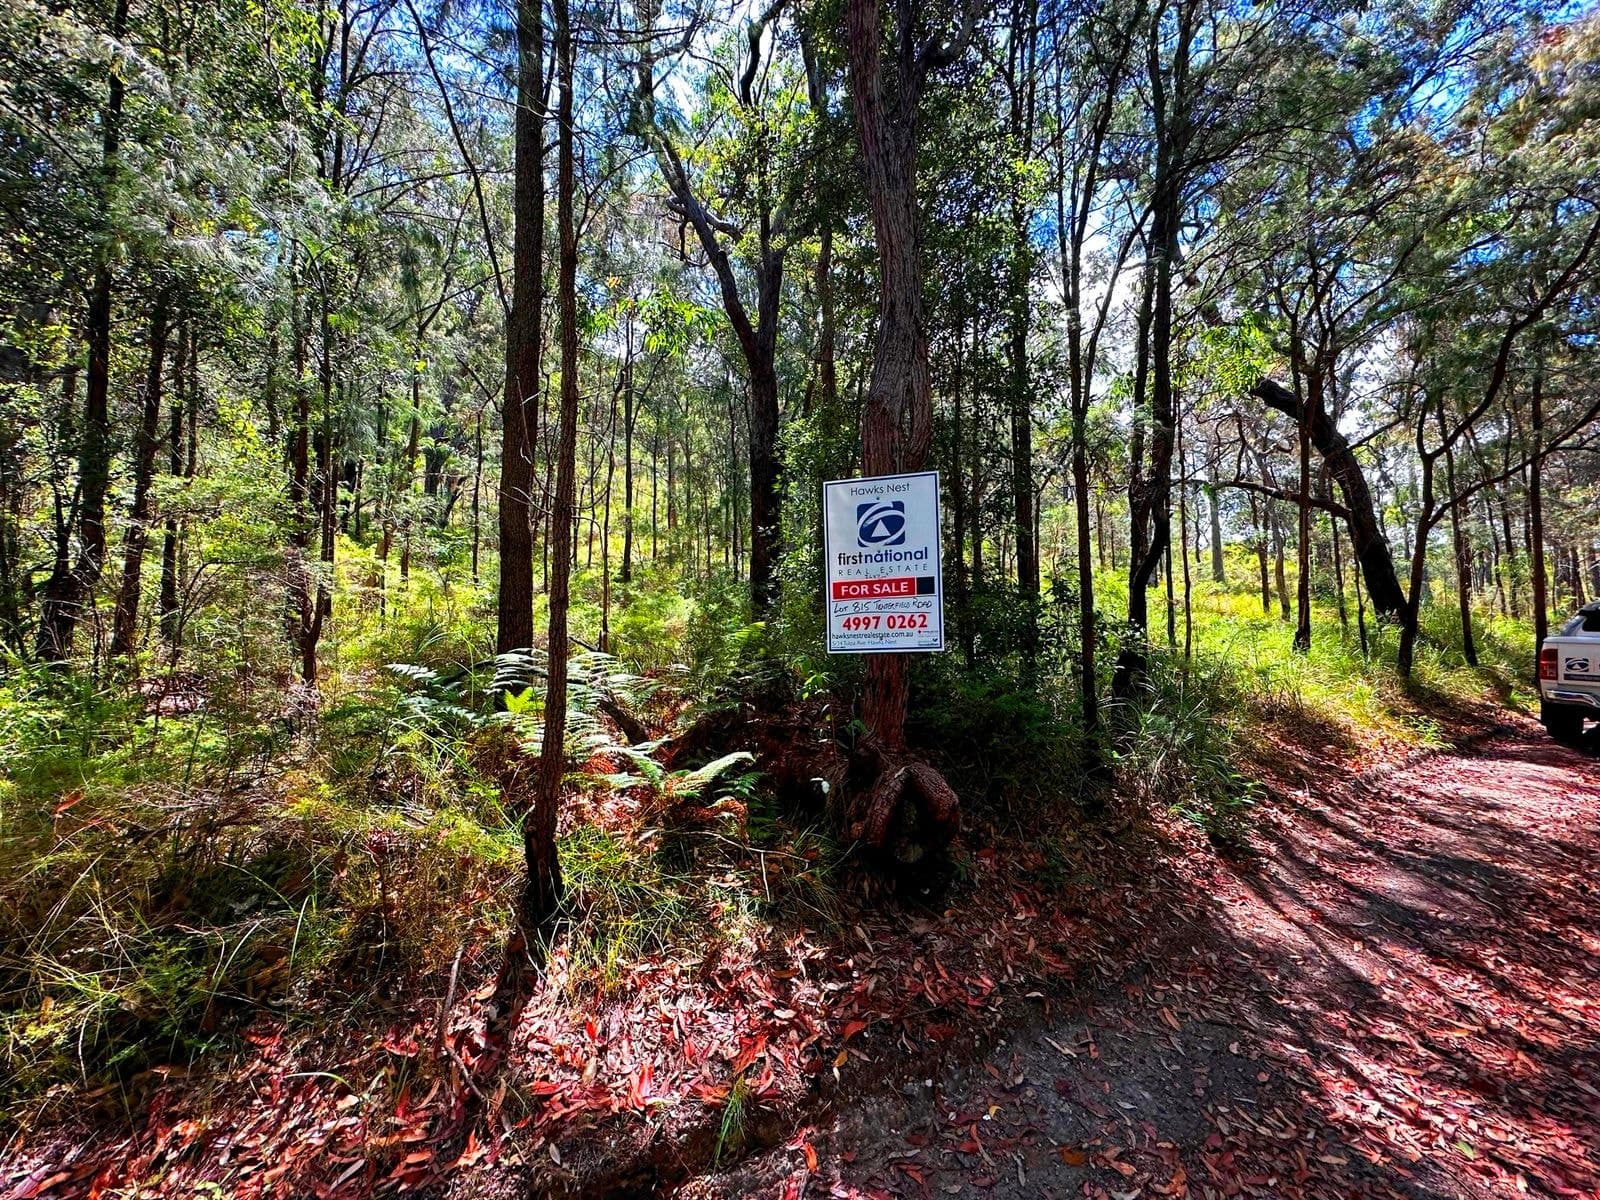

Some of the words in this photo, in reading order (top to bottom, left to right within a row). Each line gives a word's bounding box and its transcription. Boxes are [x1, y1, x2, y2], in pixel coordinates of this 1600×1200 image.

[851, 486, 884, 496] Hawks
[887, 483, 910, 493] Nest
[838, 547, 928, 566] firstnational
[839, 568, 870, 577] REAL
[880, 564, 928, 573] ESTATE
[841, 585, 870, 596] FOR
[873, 582, 909, 594] SALE
[853, 600, 871, 612] 815
[842, 616, 881, 631] 4997
[887, 614, 928, 629] 0262
[832, 631, 914, 640] hawksnestrealestate.com.au
